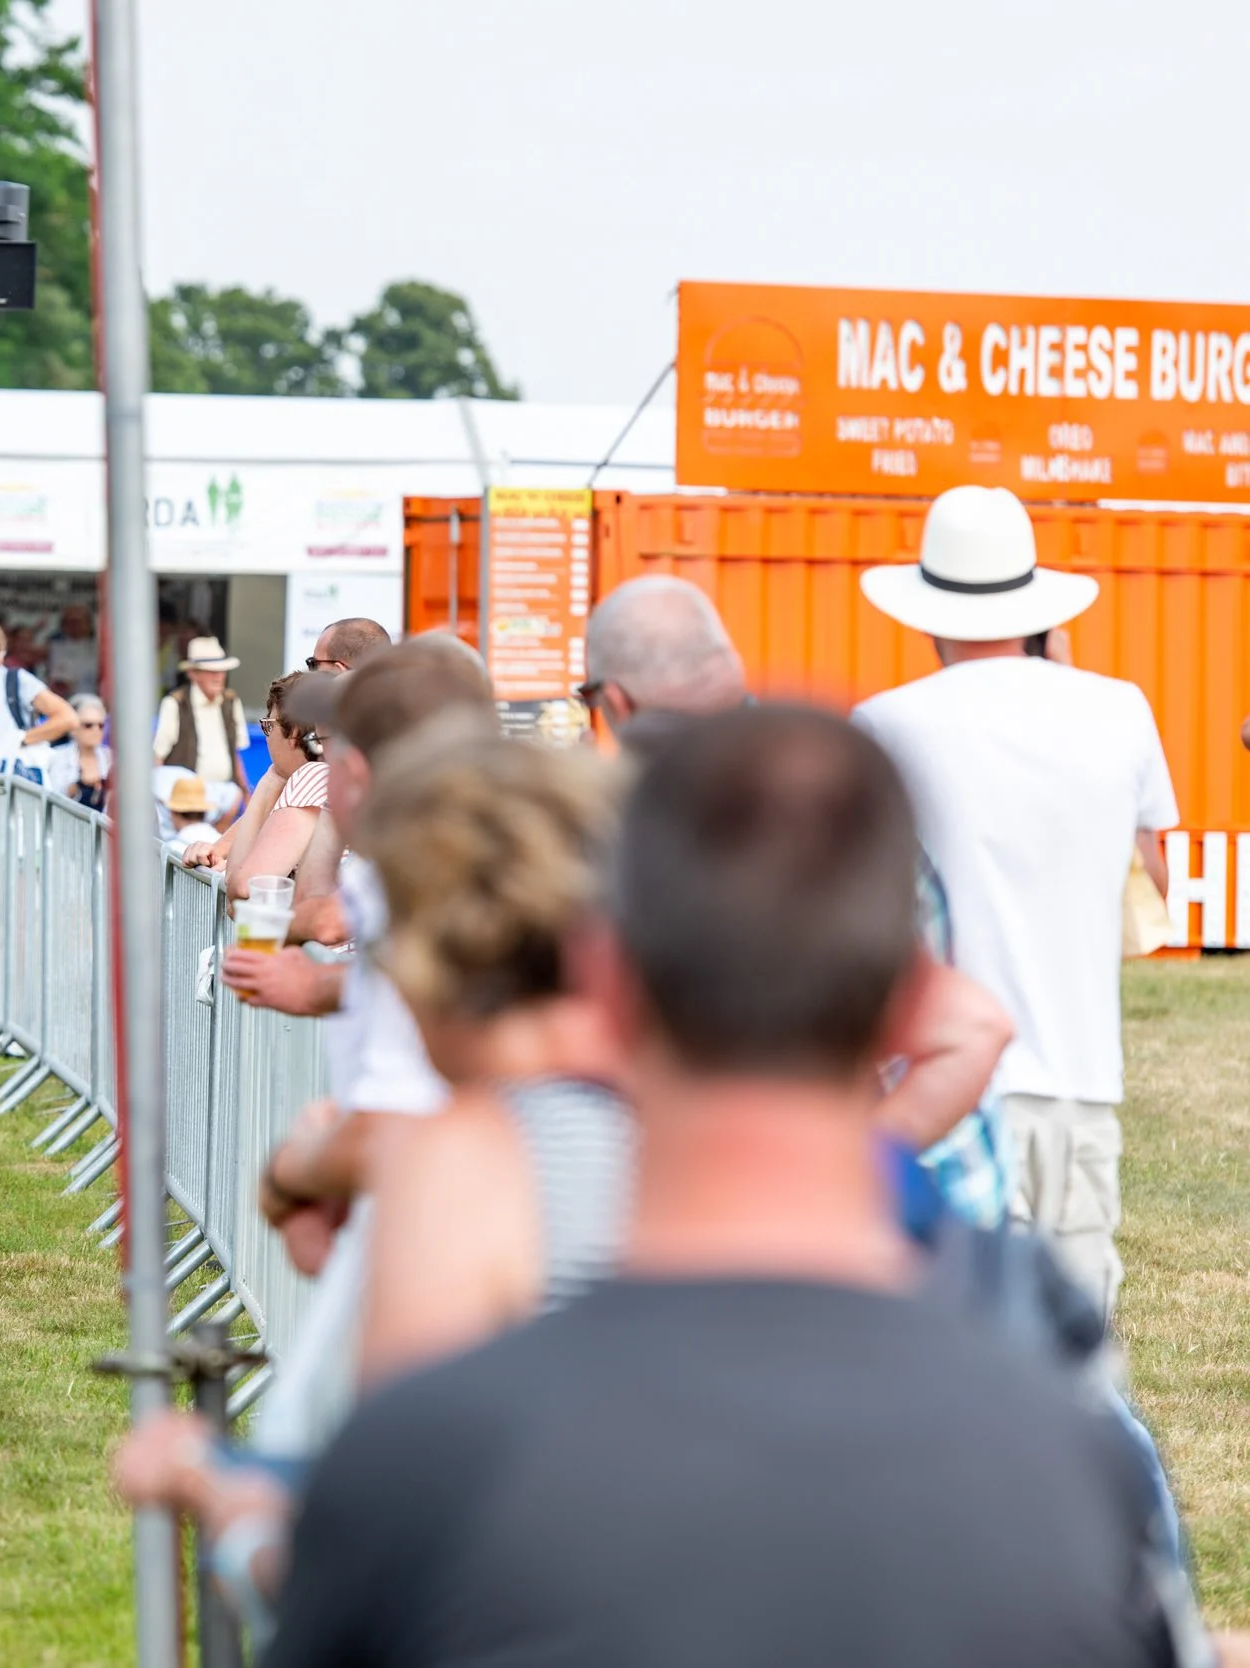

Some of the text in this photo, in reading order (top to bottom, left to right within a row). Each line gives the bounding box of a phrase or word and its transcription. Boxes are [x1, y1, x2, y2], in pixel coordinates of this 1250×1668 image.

[837, 317, 925, 392] MAC
[938, 321, 967, 393] &
[980, 322, 1139, 400] CHEESE
